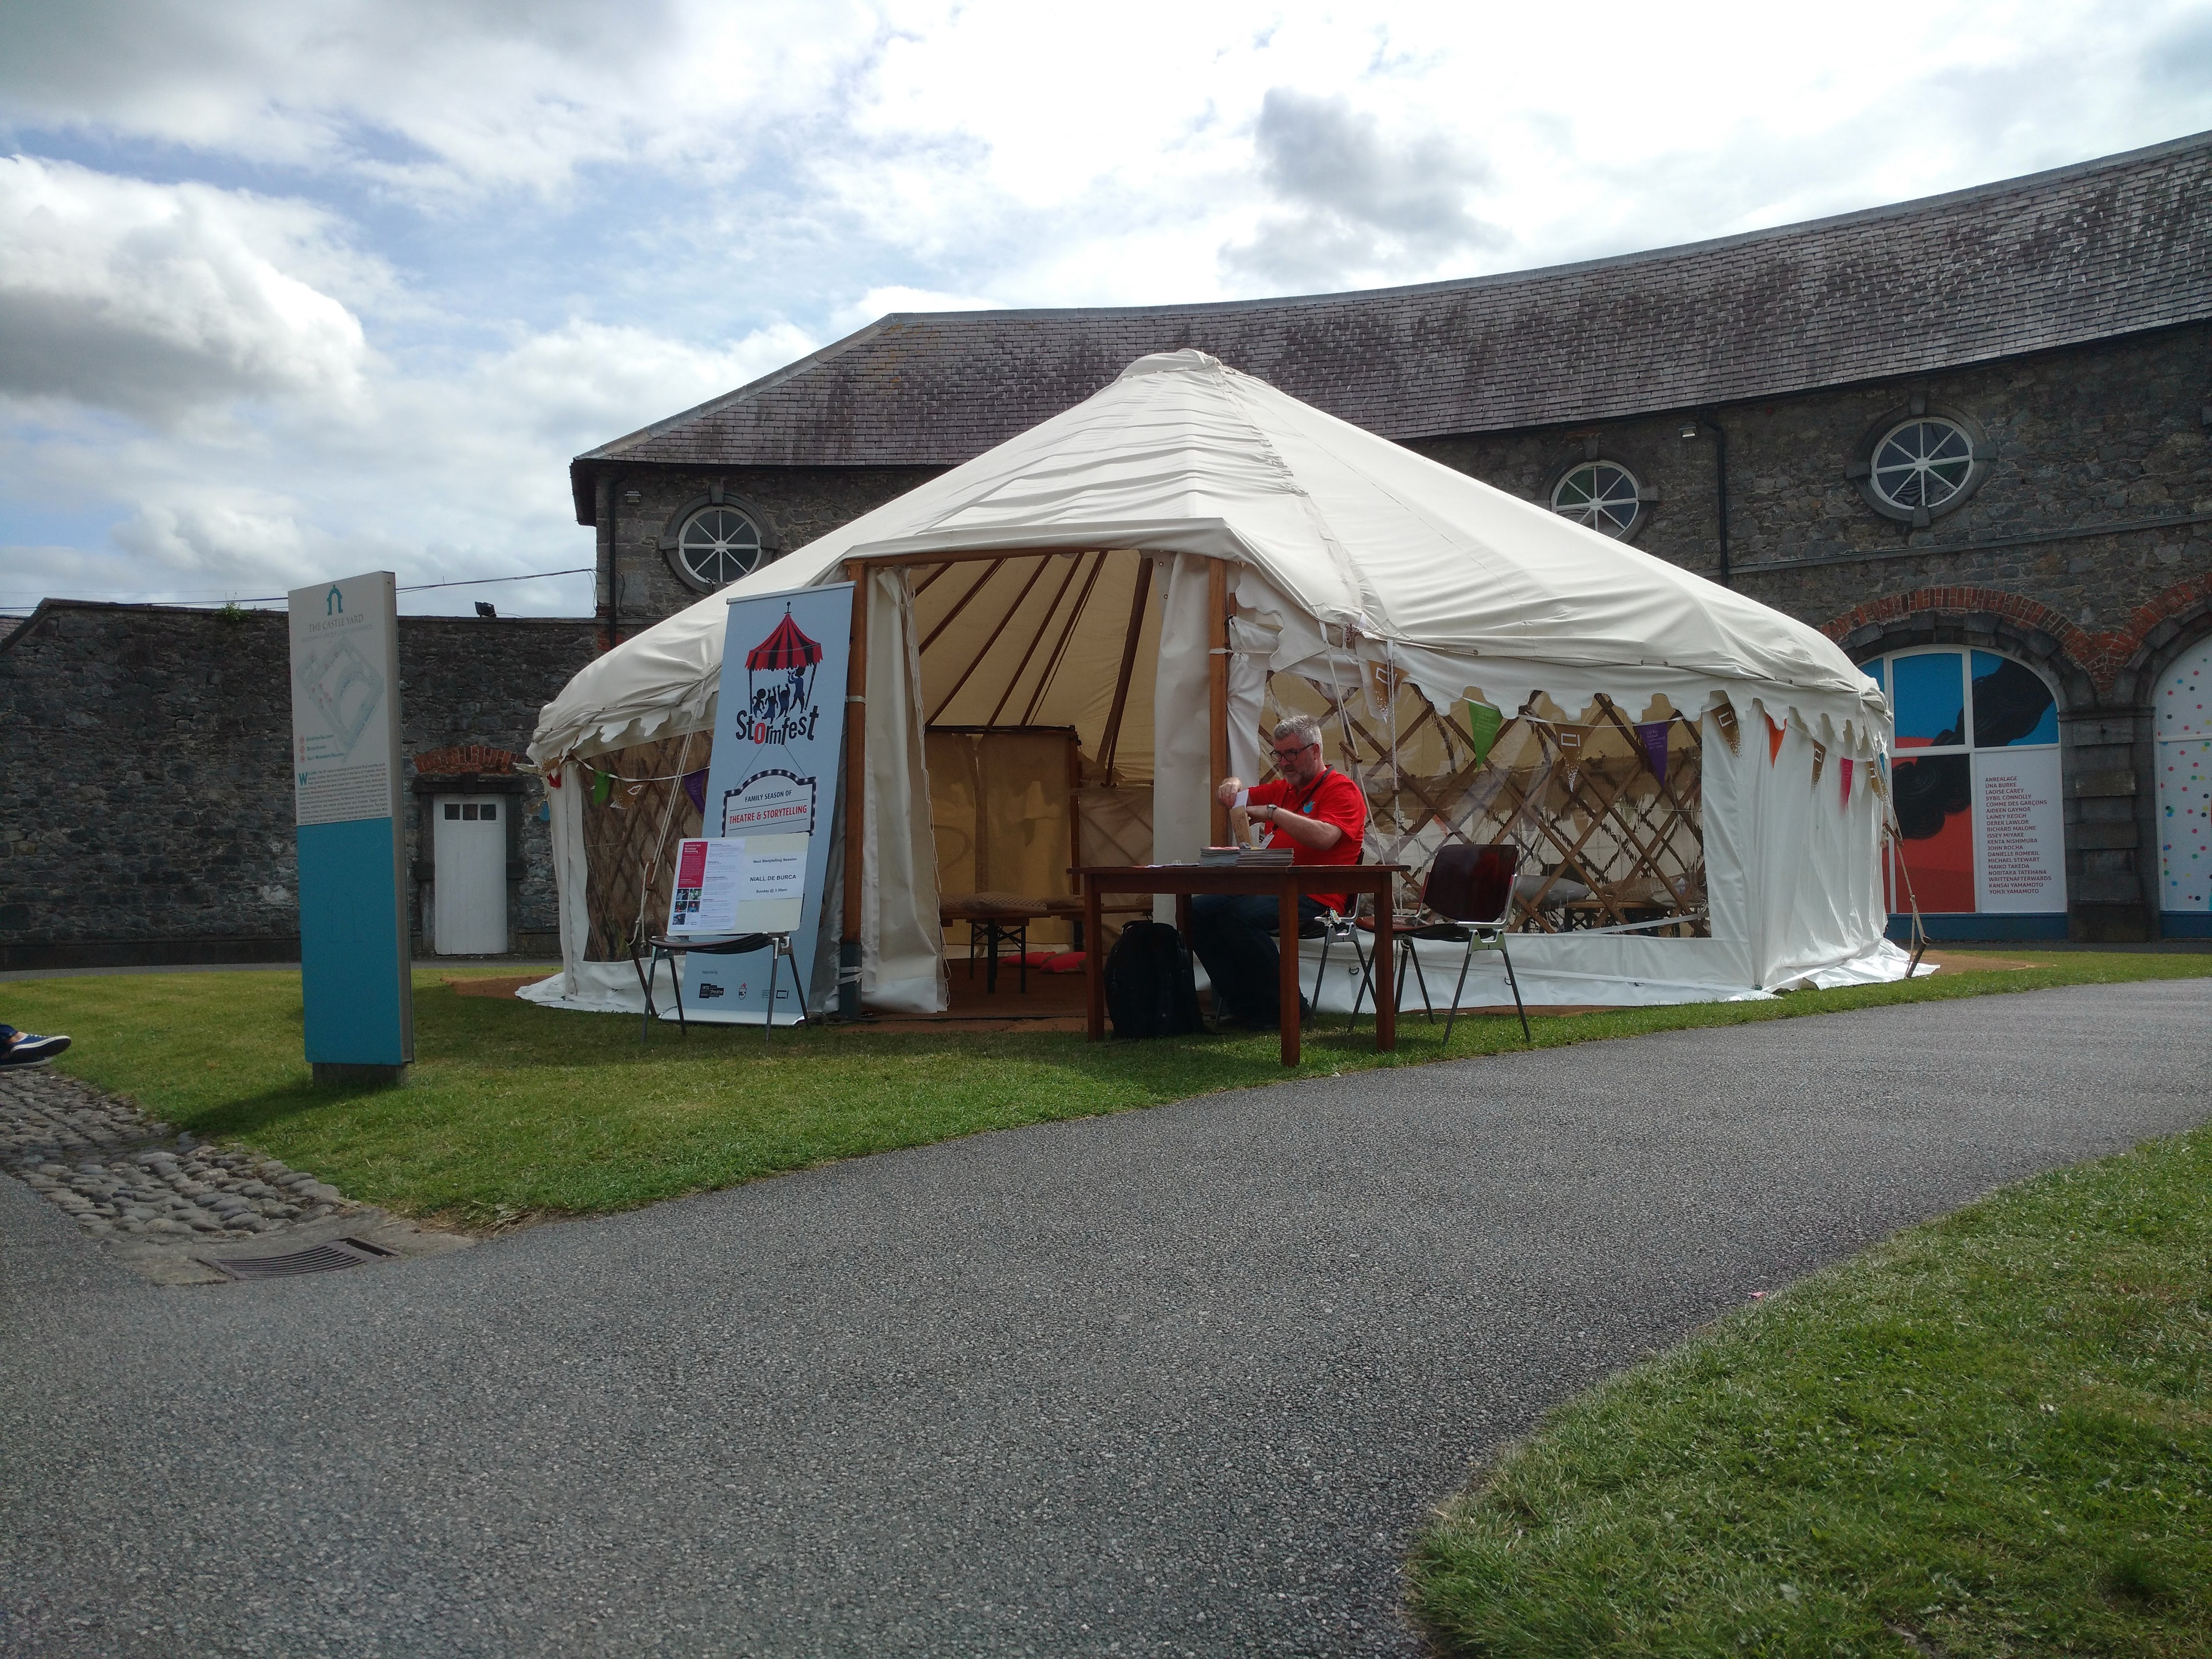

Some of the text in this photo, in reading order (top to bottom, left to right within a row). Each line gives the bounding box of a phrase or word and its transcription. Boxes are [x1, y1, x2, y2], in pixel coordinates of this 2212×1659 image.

[309, 614, 364, 632] THE CASTLE YARD
[736, 705, 819, 745] Stormfest
[745, 795, 763, 803] FAMILY
[764, 791, 784, 799] SEASON
[730, 805, 807, 824] THEATRE & STORYTELLING
